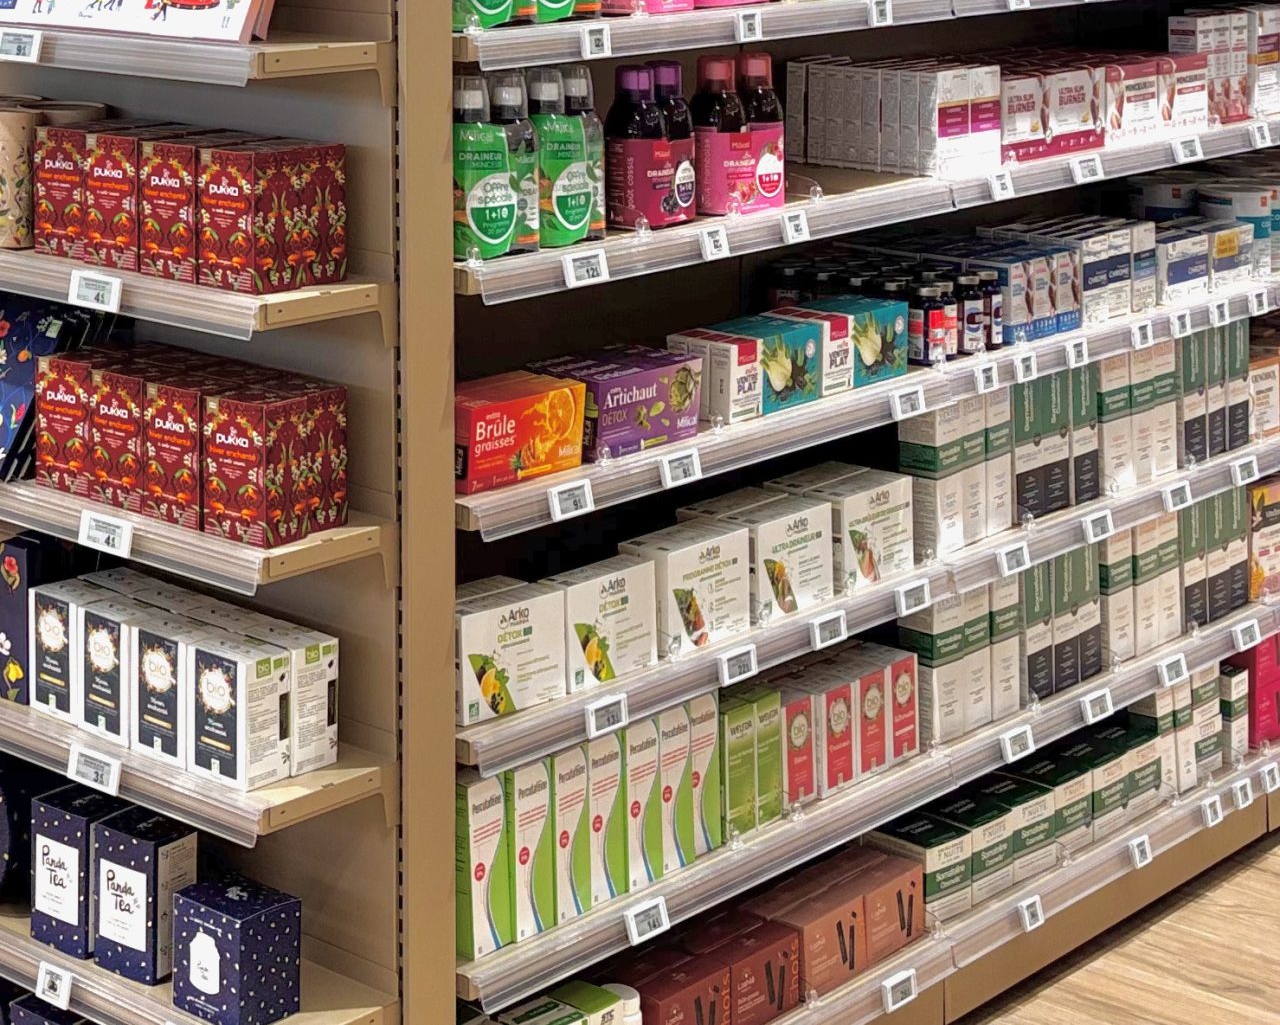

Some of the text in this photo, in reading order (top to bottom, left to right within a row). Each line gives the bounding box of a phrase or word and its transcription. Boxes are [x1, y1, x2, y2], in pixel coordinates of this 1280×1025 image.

[44, 158, 74, 171] pukka
[93, 166, 123, 179] pukka
[150, 175, 180, 189] pukka
[208, 183, 239, 197] pukka
[46, 390, 76, 405] pukka
[603, 382, 657, 409] Artichaut
[99, 404, 129, 419] pukka
[602, 409, 628, 427] DÉTOX
[154, 418, 185, 434] pukka
[475, 415, 516, 441] Brûle
[215, 432, 249, 448] pukka
[475, 435, 516, 458] graisses
[508, 606, 530, 620] Arko
[41, 843, 69, 873] Panda
[48, 865, 68, 890] Tea
[106, 868, 135, 899] Panda
[111, 890, 135, 915] Tea
